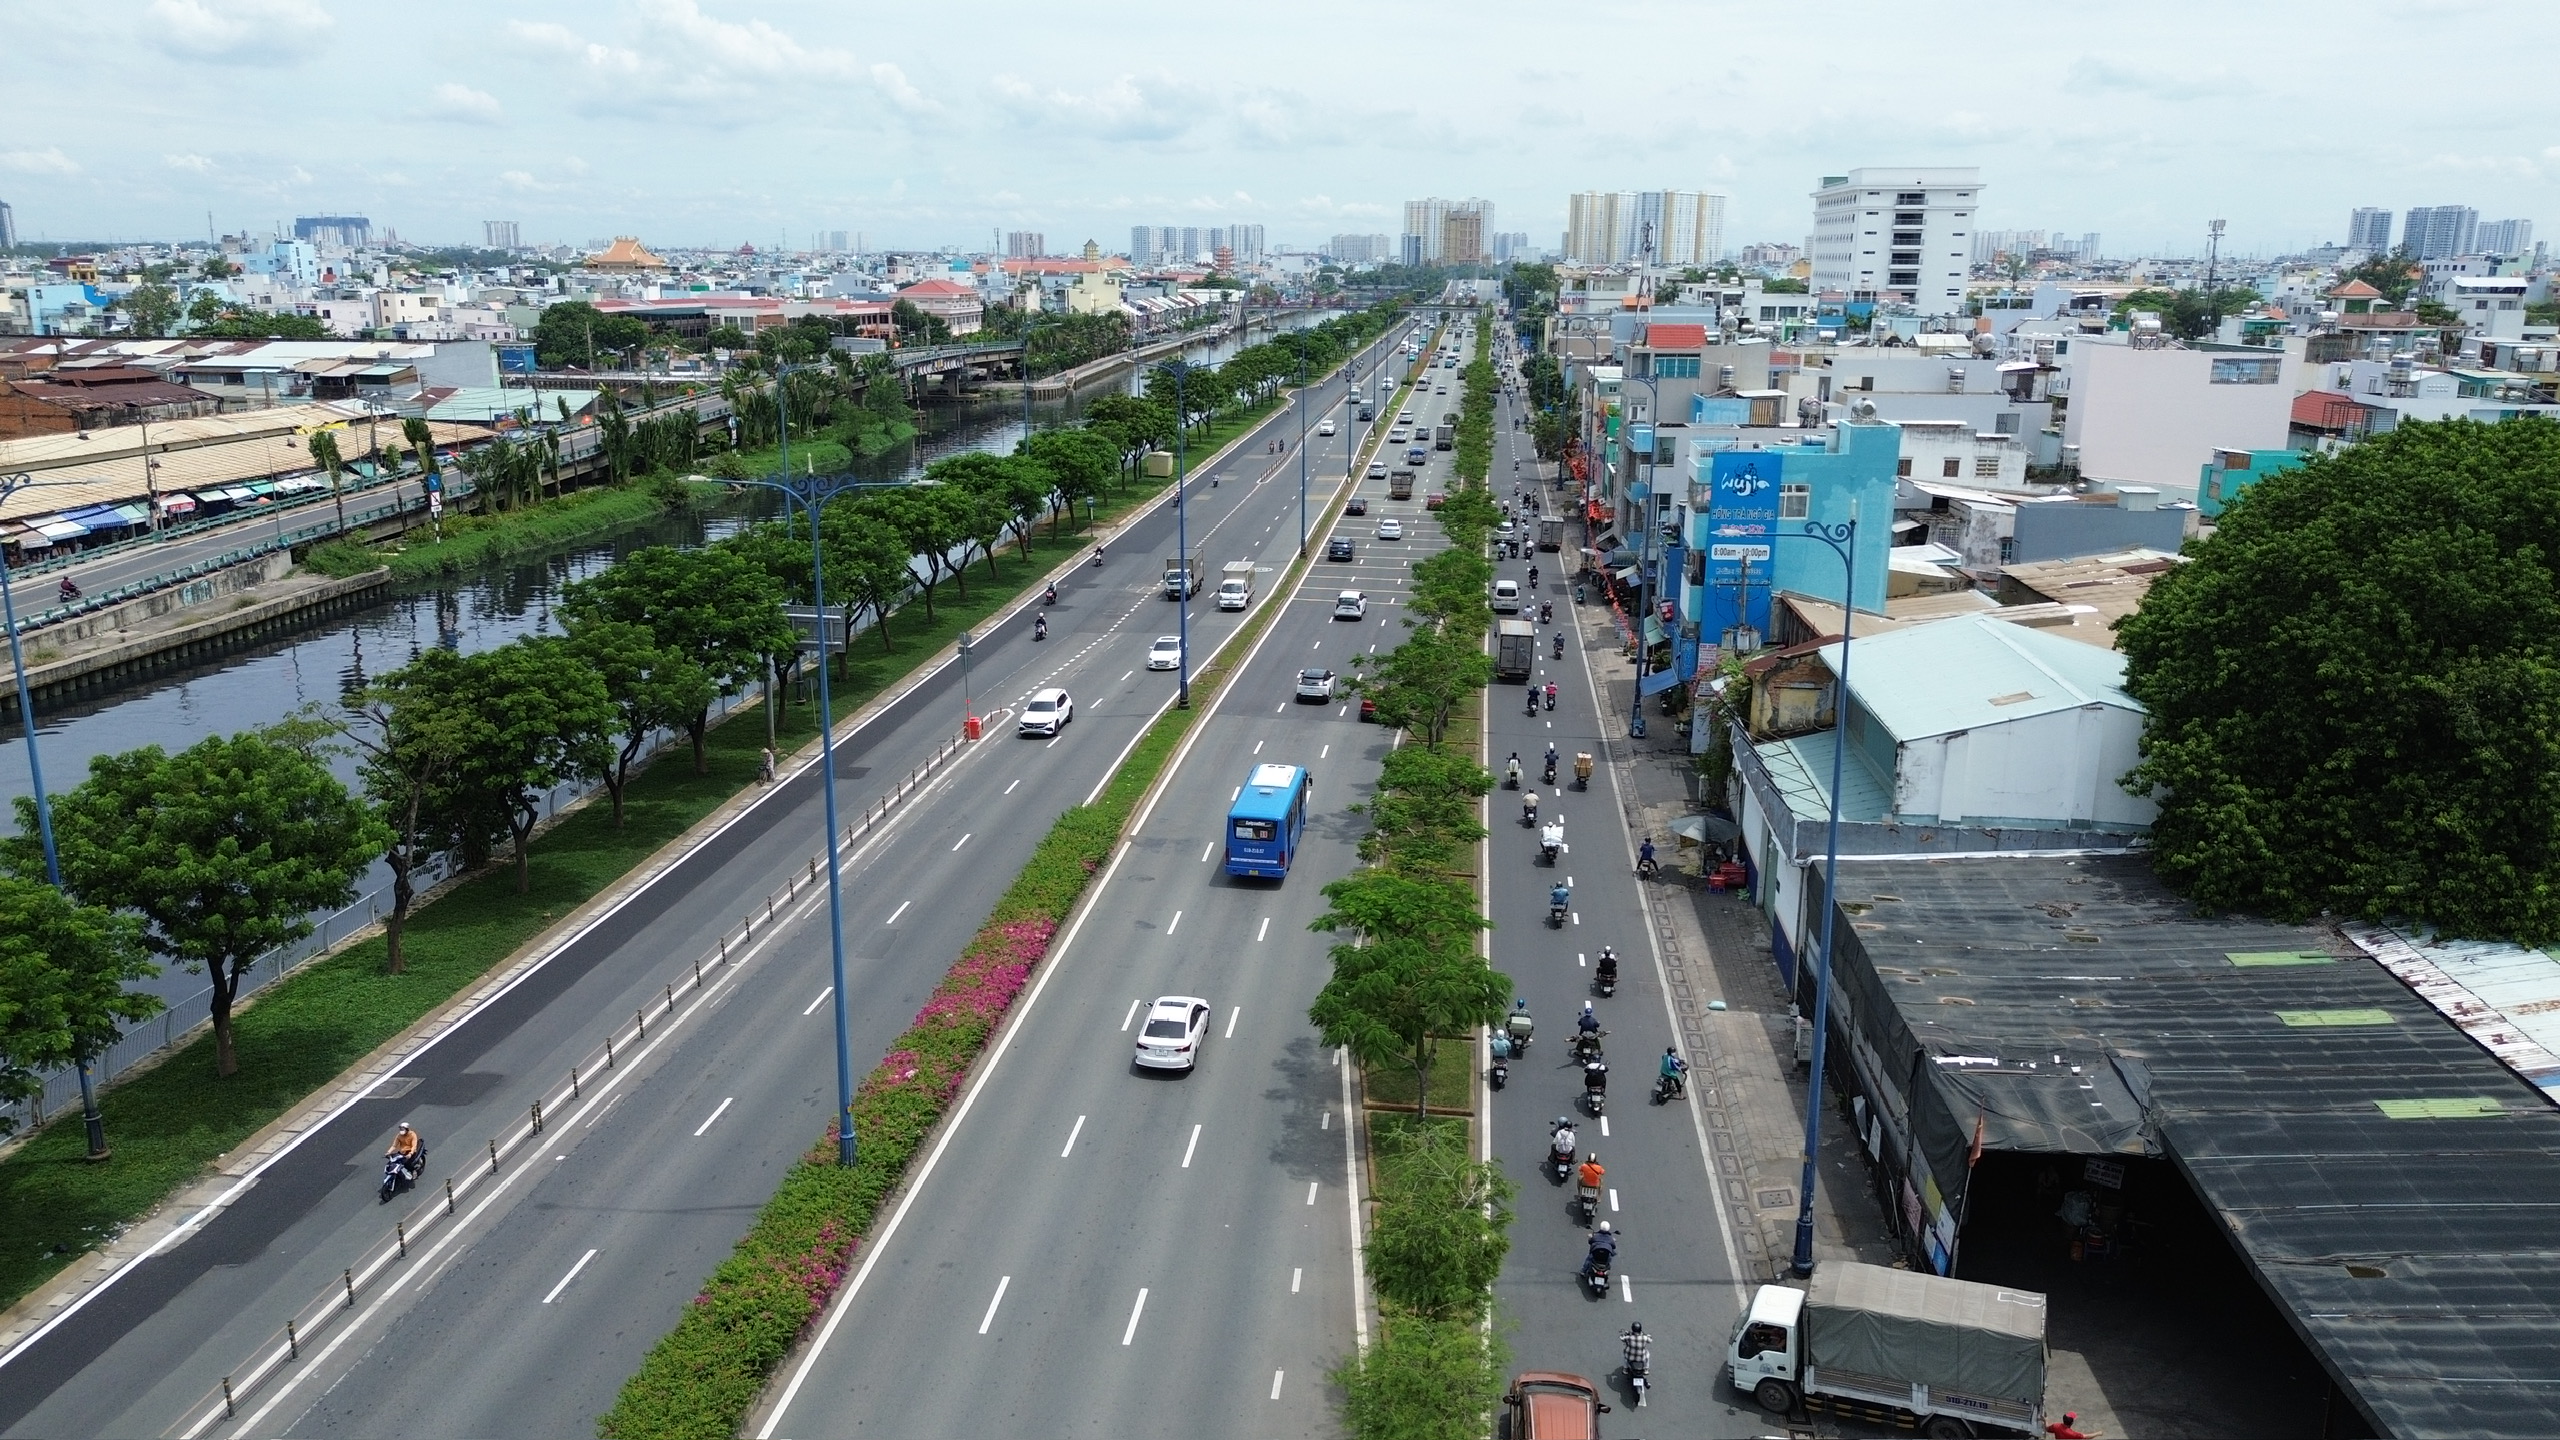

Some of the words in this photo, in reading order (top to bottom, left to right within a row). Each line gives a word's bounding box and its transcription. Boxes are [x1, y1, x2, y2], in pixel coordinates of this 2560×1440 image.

[1763, 509, 1775, 520] GIA
[1713, 547, 1736, 556] 8:00am
[1742, 547, 1768, 558] 10:00pm
